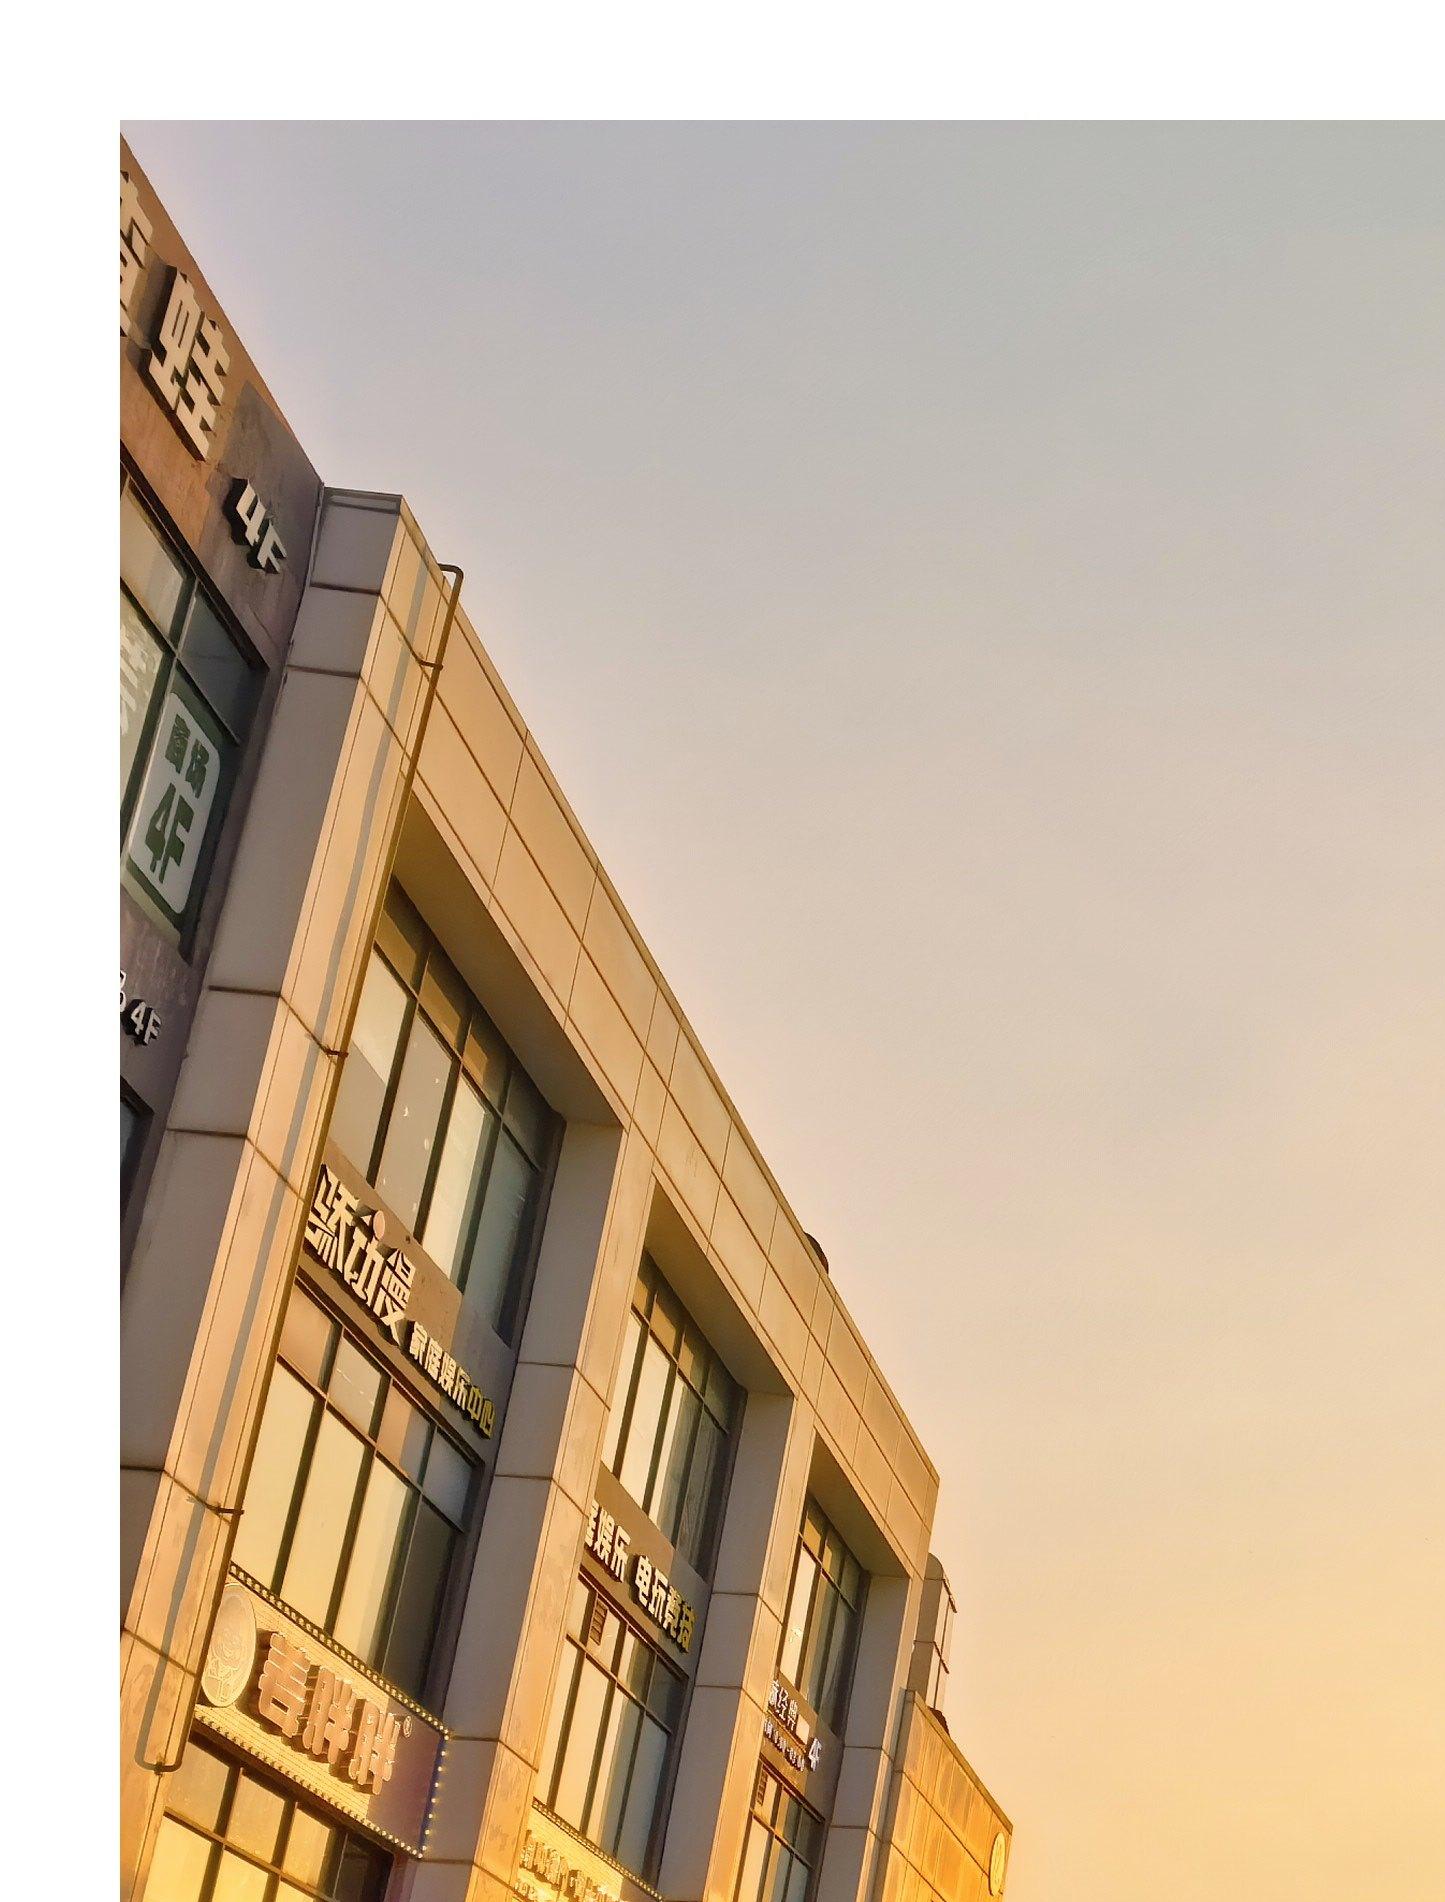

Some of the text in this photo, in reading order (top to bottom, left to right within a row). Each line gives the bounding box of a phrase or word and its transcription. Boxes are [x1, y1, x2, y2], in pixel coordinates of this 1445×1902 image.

[234, 479, 288, 574] 4F
[144, 781, 195, 884] 4F
[130, 1001, 162, 1044] 4F
